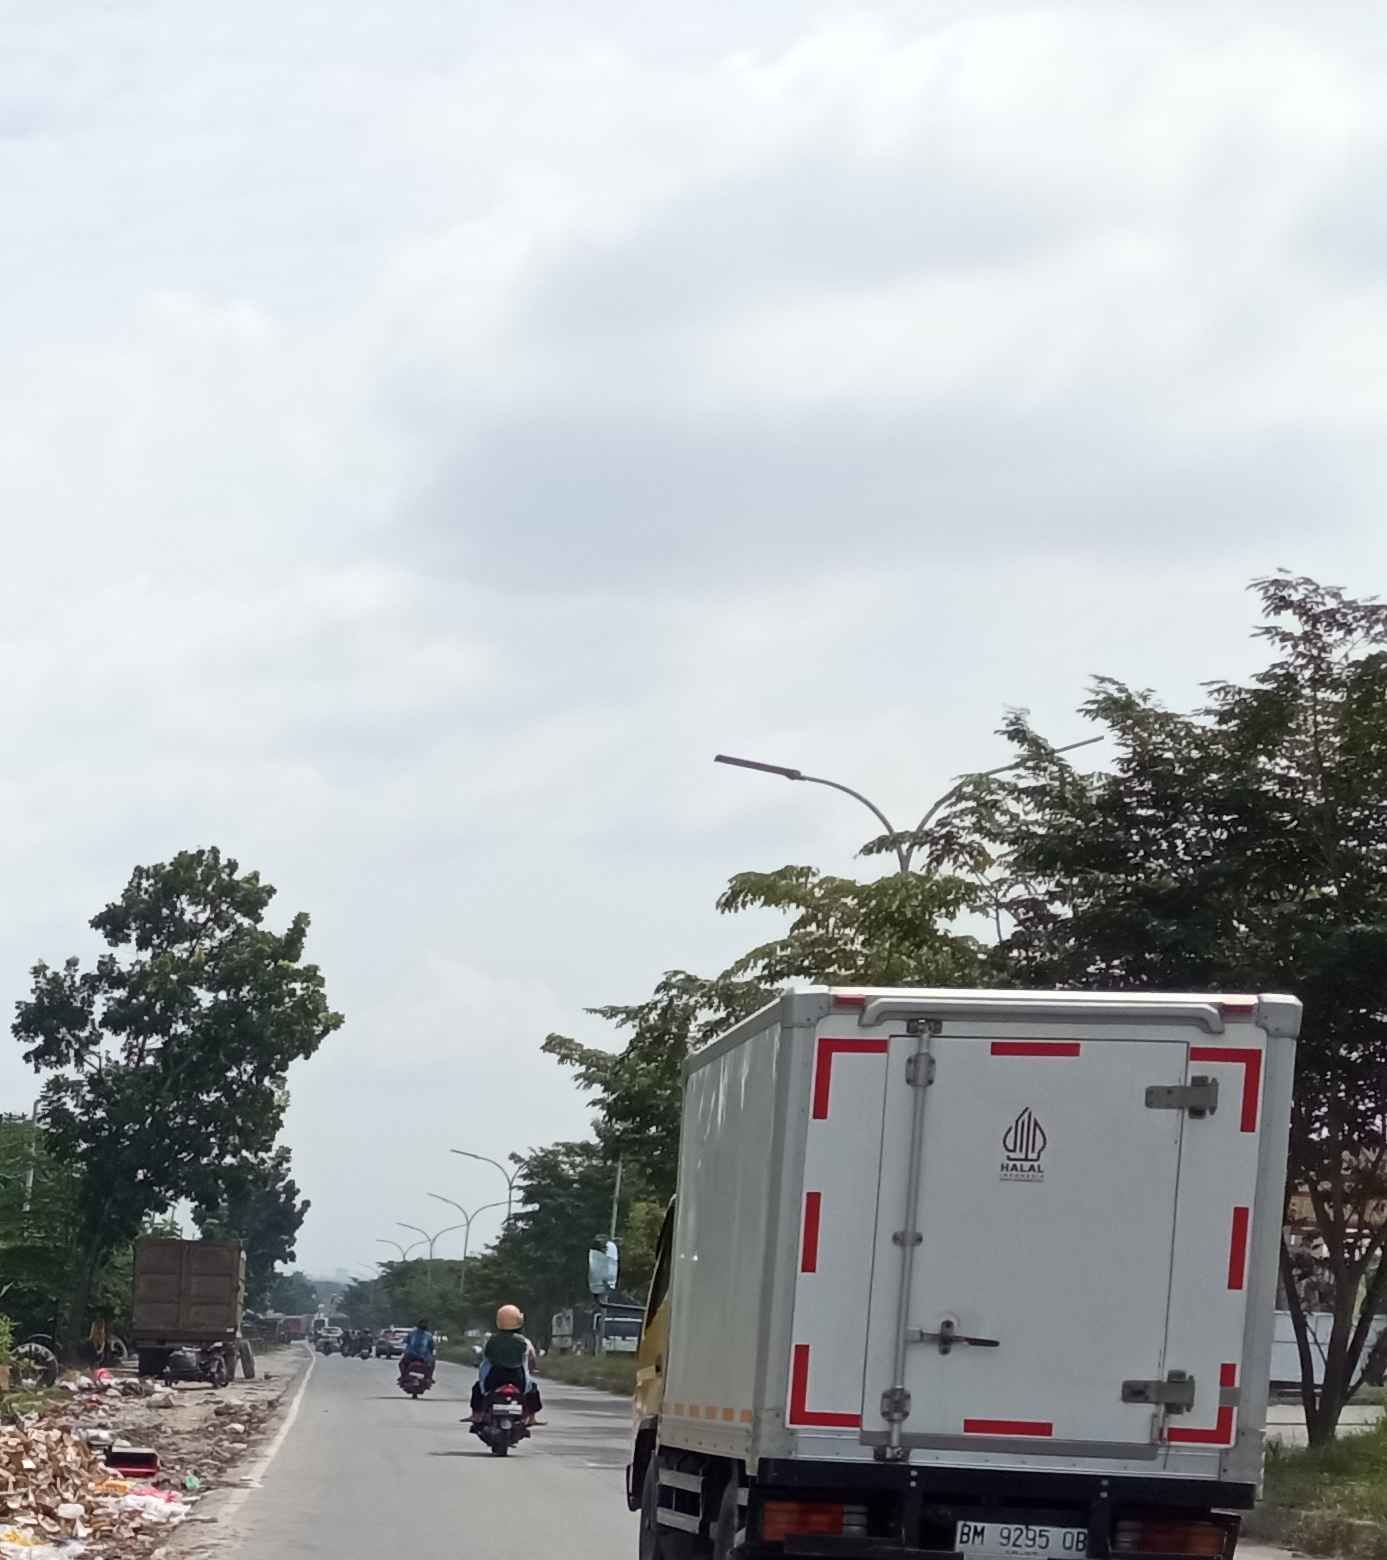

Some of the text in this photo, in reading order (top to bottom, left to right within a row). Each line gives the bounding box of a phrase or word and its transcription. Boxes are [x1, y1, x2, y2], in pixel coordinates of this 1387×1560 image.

[1000, 1163, 1045, 1174] HALAL
[959, 1523, 986, 1546] BM
[999, 1526, 1051, 1550] 9295
